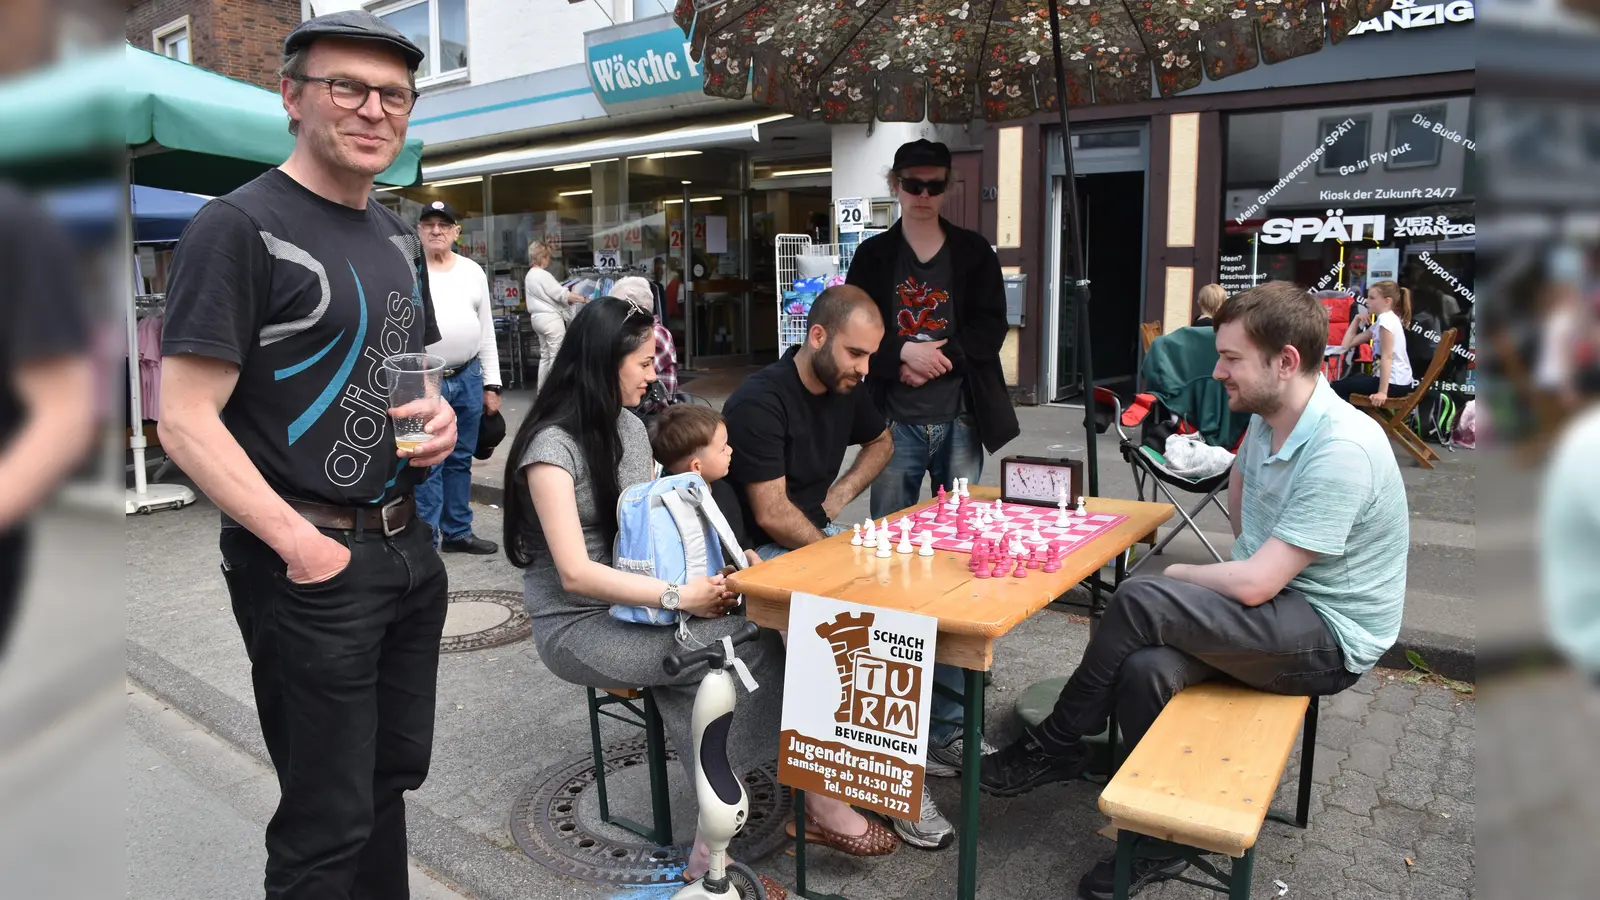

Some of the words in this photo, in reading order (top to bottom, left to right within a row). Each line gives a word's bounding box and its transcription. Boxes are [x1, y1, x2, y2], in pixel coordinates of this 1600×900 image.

[592, 48, 681, 93] Wäsche
[1411, 113, 1431, 129] Die
[1432, 122, 1462, 143] Bude
[1339, 163, 1355, 176] Go
[1357, 160, 1369, 170] in
[1370, 151, 1388, 166] Fly
[1390, 142, 1412, 157] out
[1235, 202, 1259, 226] Mein
[1257, 143, 1327, 206] Grundversorger
[1324, 118, 1357, 147] SPÄTI
[982, 187, 997, 200] 20
[1320, 190, 1350, 200] Kiosk
[1353, 189, 1373, 199] der
[1375, 188, 1423, 199] Zukunft
[1424, 187, 1457, 199] 24/7
[841, 208, 862, 222] 20
[1261, 208, 1386, 245] SPÄTI
[1394, 216, 1434, 227] VIER
[1436, 215, 1450, 226] &
[1394, 223, 1475, 237] ZWANZIG
[1220, 264, 1247, 273] Fragen?
[1220, 272, 1267, 280] Beschwerden?
[1317, 275, 1332, 289] als
[1330, 260, 1346, 276] nie
[1418, 250, 1458, 287] Support
[1454, 283, 1475, 303] you
[505, 287, 518, 298] 20
[1411, 321, 1423, 334] in
[1423, 329, 1441, 343] die
[325, 291, 416, 487] adidas
[1441, 381, 1457, 391] ist
[873, 629, 925, 650] SCHACH
[890, 646, 923, 662] CLUB
[835, 725, 918, 756] BEVERUNGEN
[788, 736, 914, 787] Jugendtraining
[787, 755, 837, 779] samstags
[839, 770, 854, 782] ab
[857, 774, 888, 792] 14:30
[890, 783, 912, 798] Uhr
[824, 779, 842, 794] Tel.
[845, 785, 910, 813] 05645-1272
